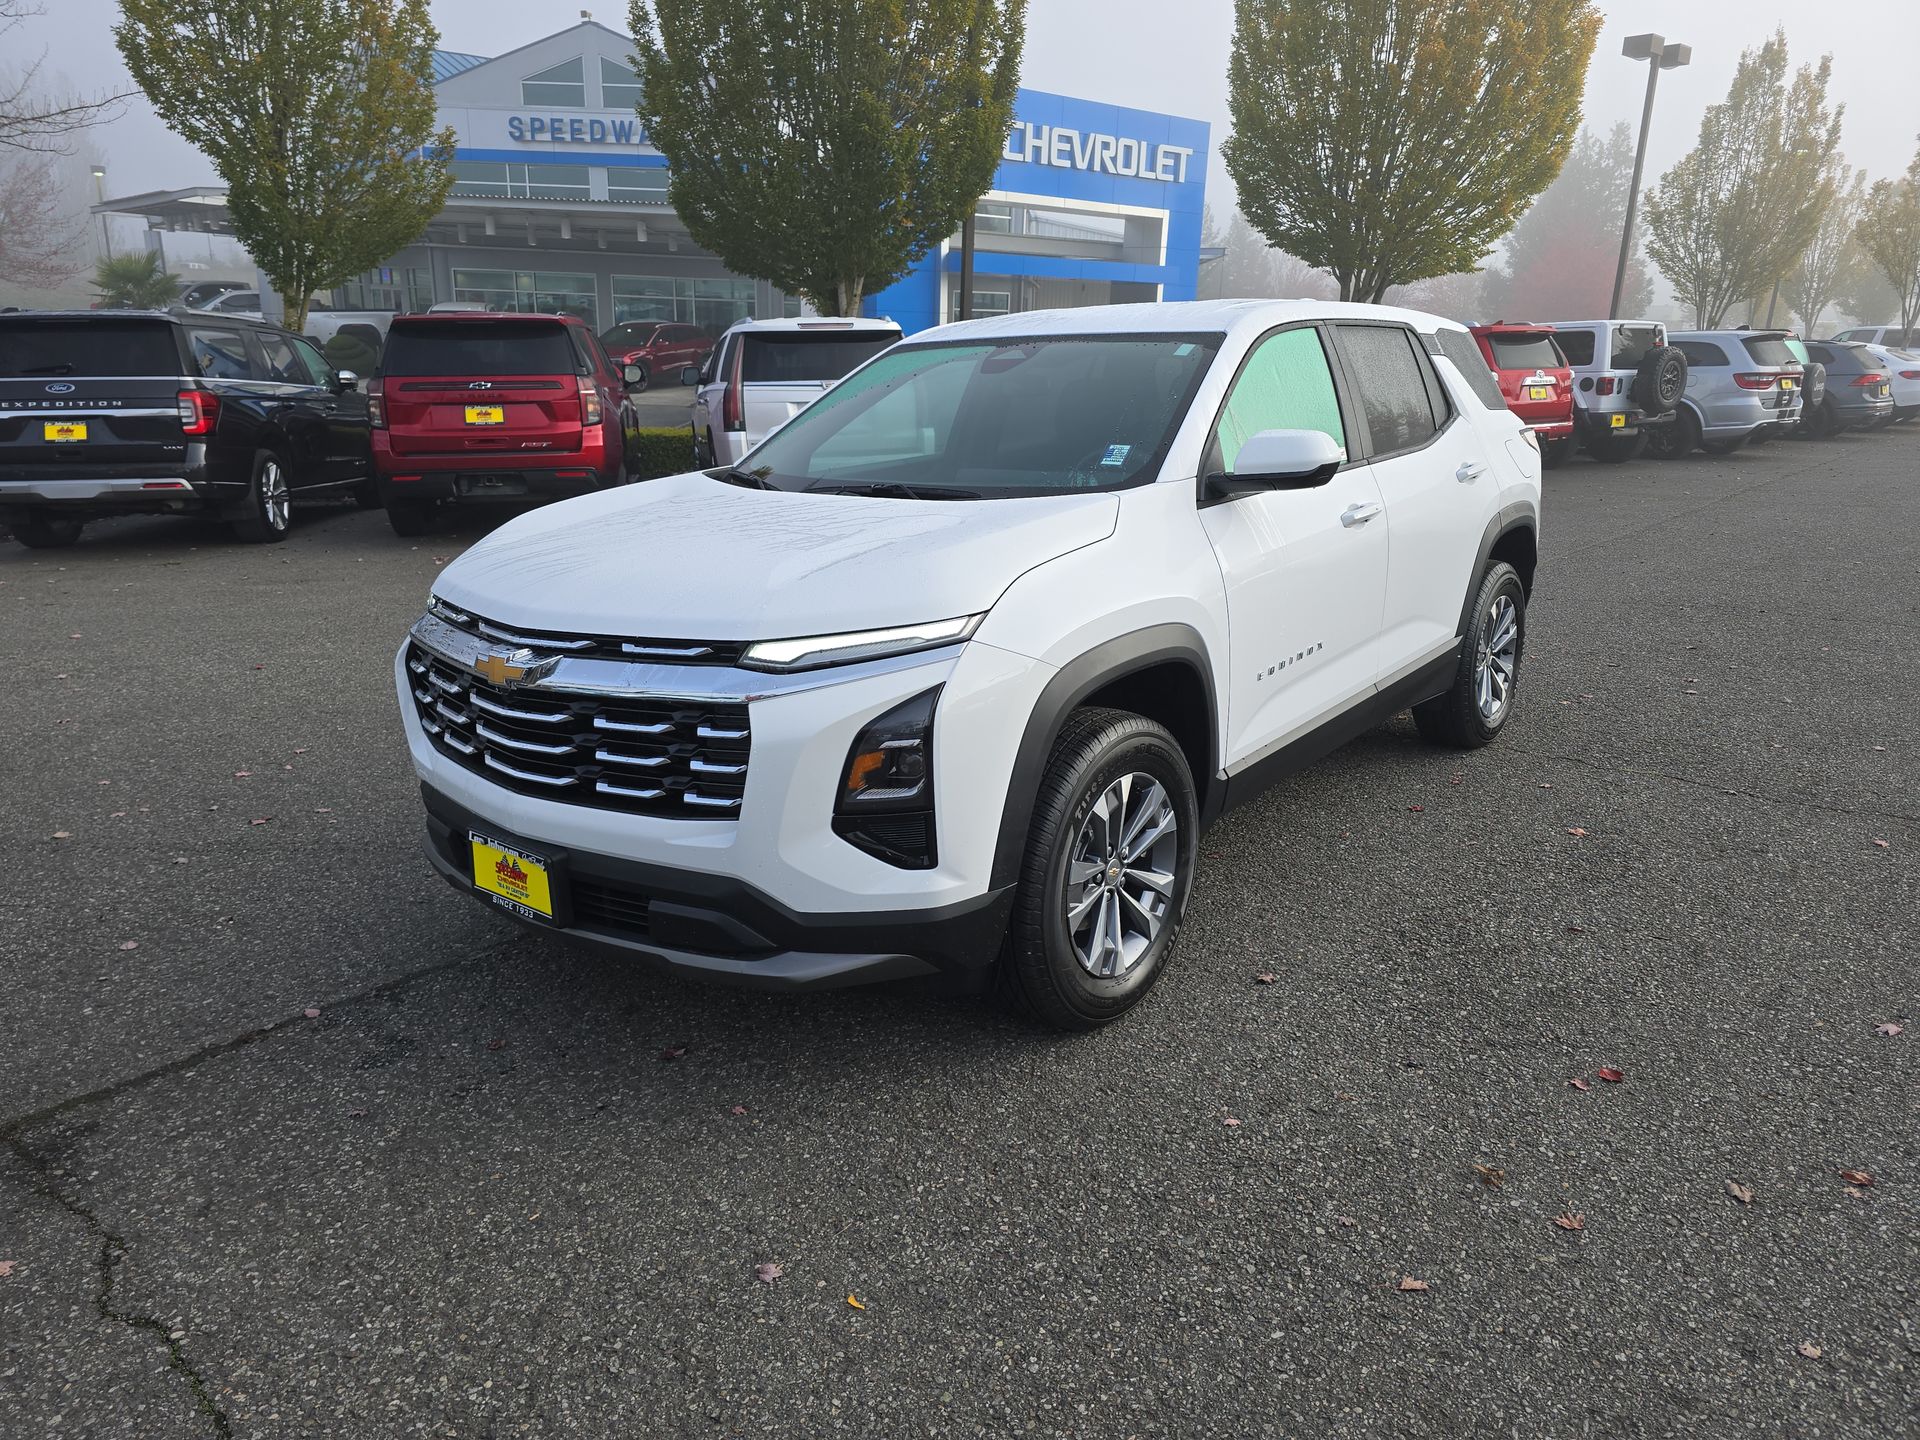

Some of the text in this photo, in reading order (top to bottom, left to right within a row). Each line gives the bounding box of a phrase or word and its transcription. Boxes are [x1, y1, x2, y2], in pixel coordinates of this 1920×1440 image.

[1002, 120, 1193, 183] CHEVROLET
[1813, 381, 1824, 392] Jeep
[492, 895, 534, 919] SINCE 1933
